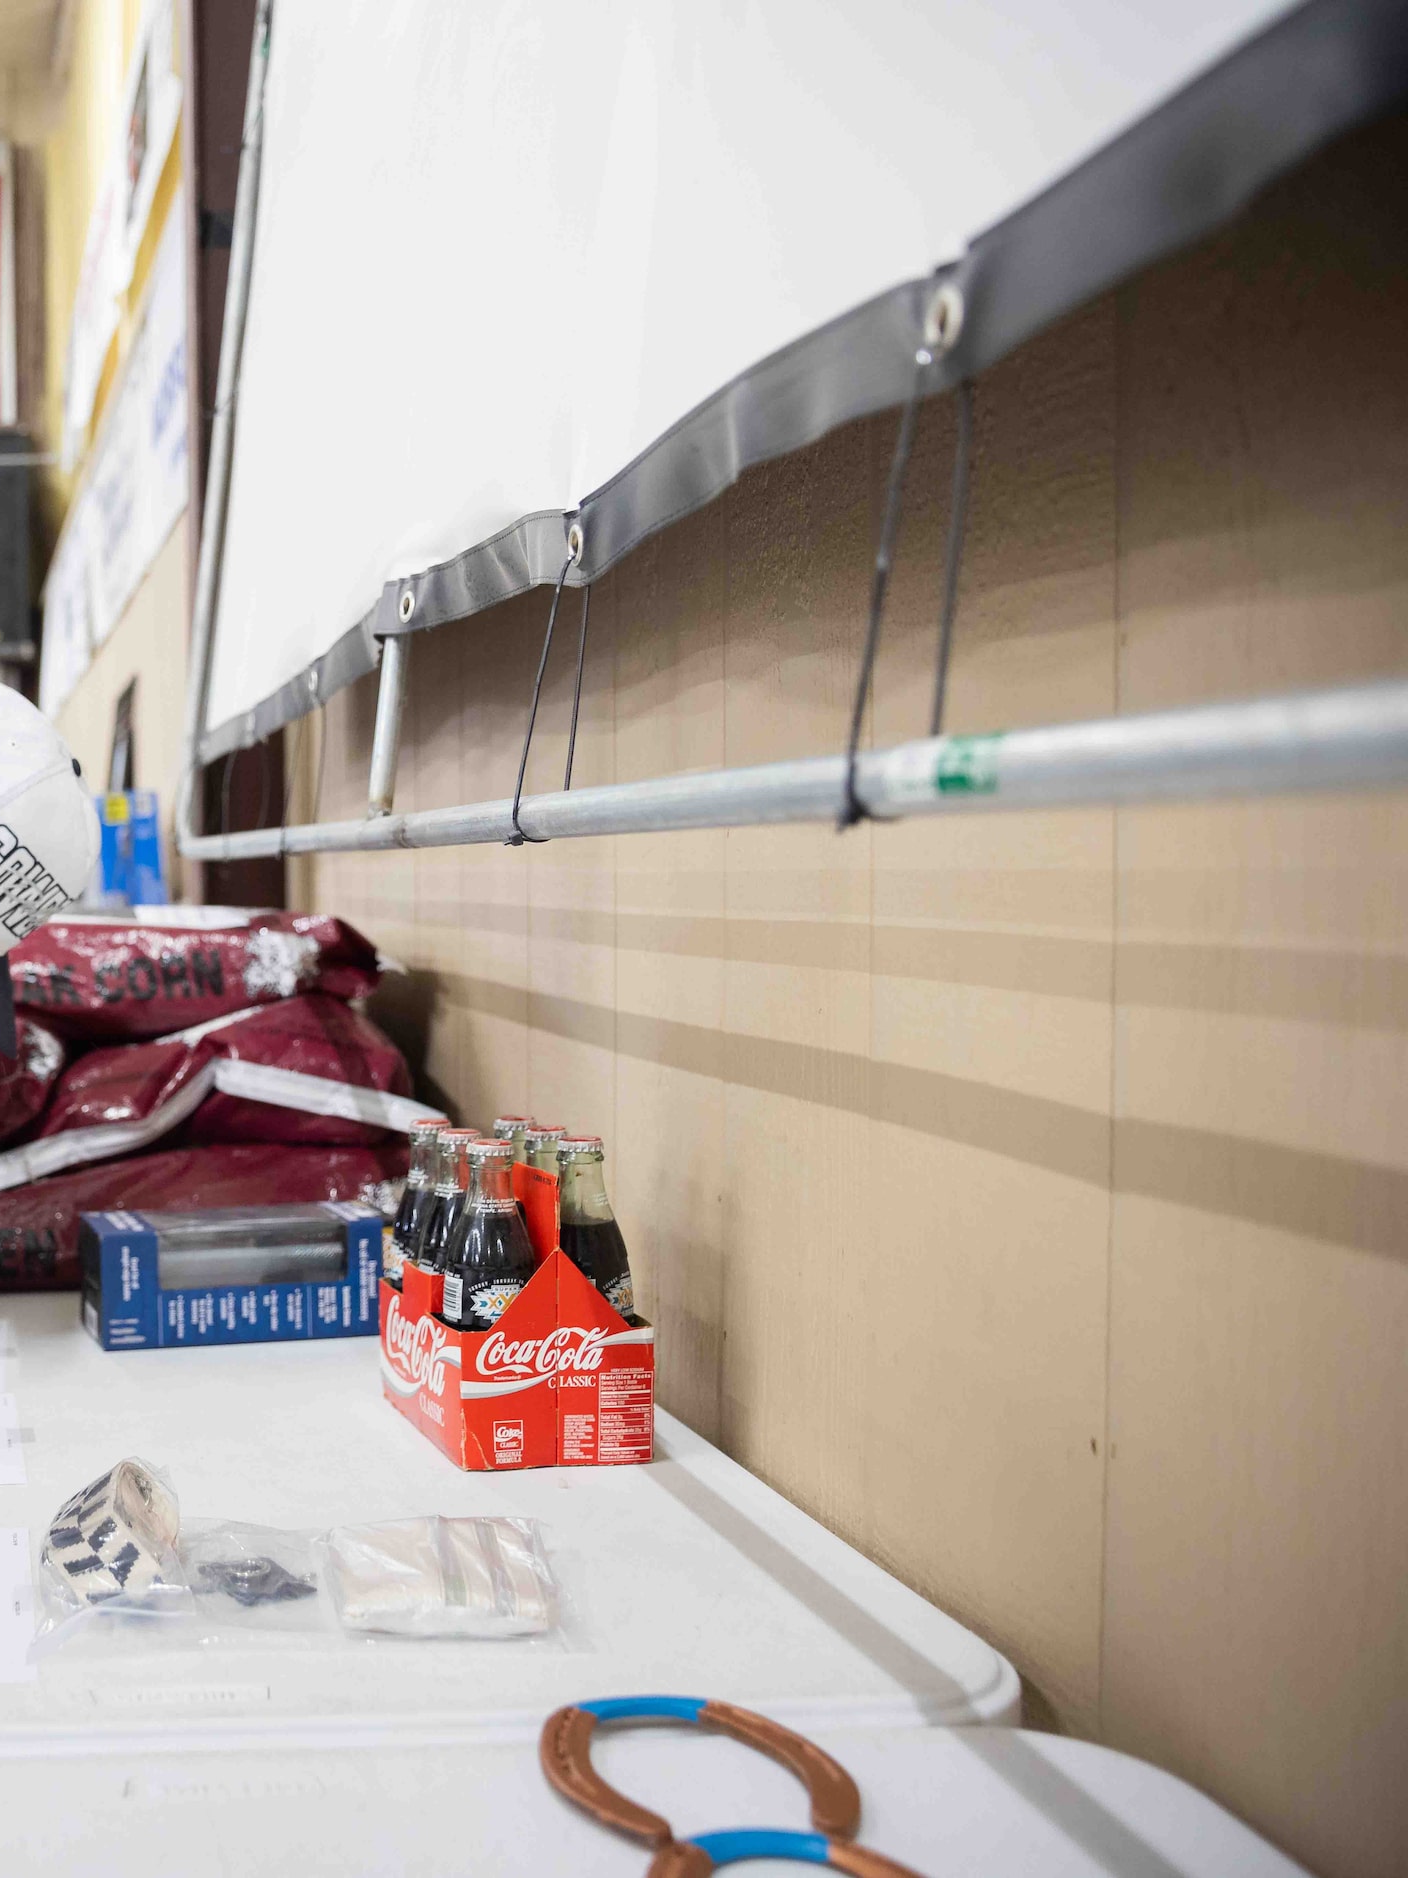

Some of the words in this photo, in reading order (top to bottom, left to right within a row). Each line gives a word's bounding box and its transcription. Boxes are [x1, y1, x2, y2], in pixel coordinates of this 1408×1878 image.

[94, 948, 225, 1003] CORN
[386, 1295, 447, 1397] Coca-Cola
[476, 1327, 609, 1376] Coca-Cola
[548, 1375, 597, 1389] CLASSIC
[419, 1392, 445, 1428] CLASSIC
[496, 1426, 522, 1438] Coke
[495, 1451, 522, 1459] ORIGINAL
